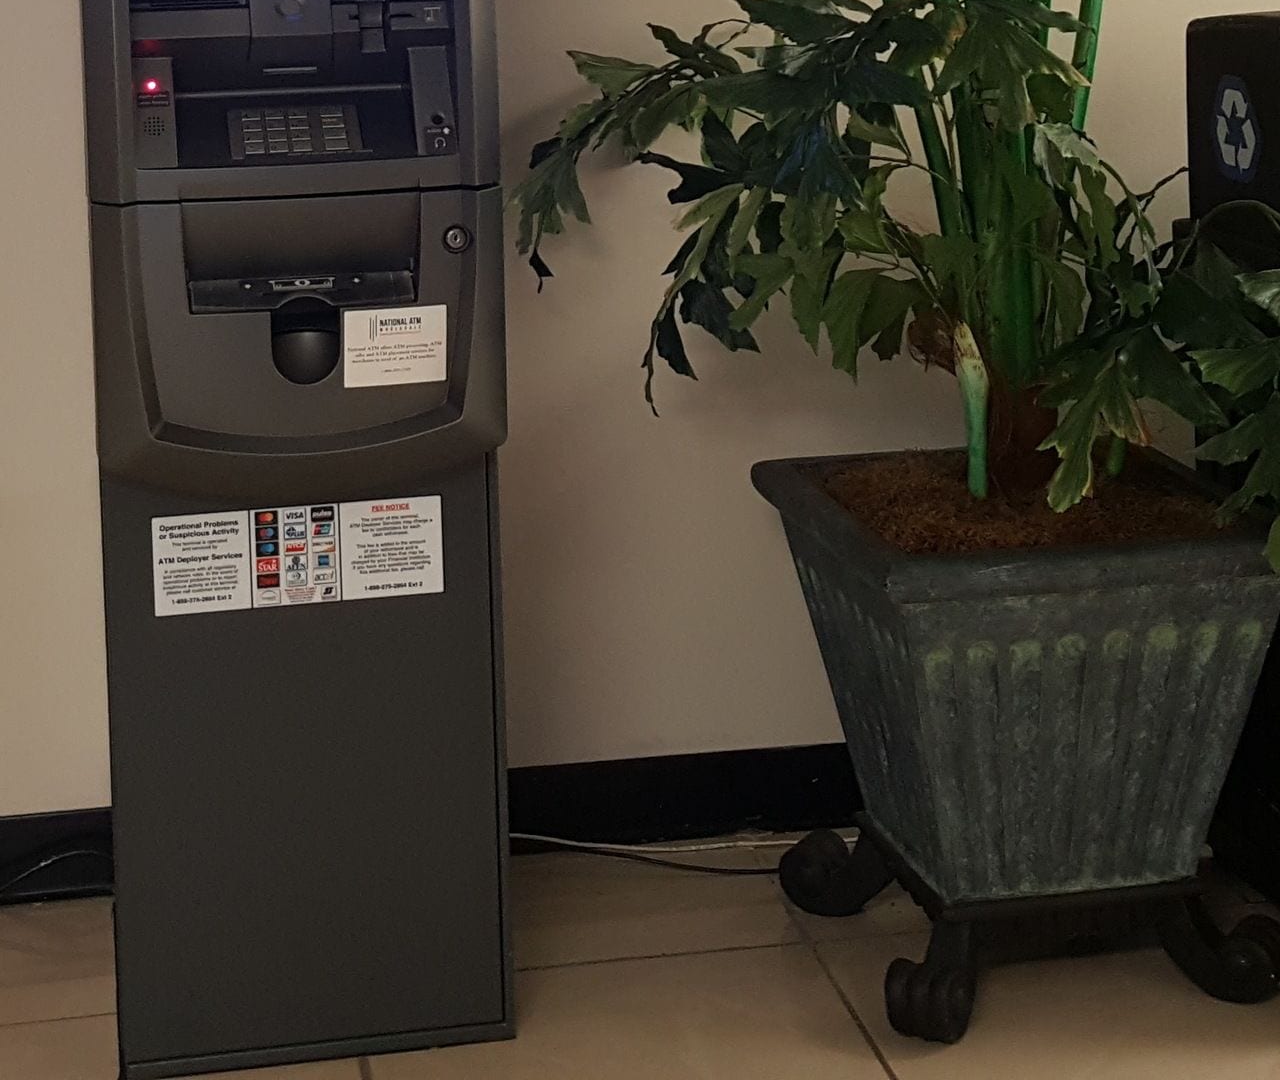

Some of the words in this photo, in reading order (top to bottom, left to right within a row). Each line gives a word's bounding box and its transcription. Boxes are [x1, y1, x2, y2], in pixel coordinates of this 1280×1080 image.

[379, 317, 407, 326] NATIONAL
[408, 316, 422, 324] ATM
[385, 503, 411, 511] NOTICE
[285, 511, 304, 520] VISA
[159, 522, 202, 533] Operational
[203, 519, 239, 528] Problems
[168, 530, 210, 540] Suspicious
[211, 527, 240, 536] Activity
[158, 557, 175, 565] ATM
[176, 555, 210, 565] Deployer
[211, 551, 243, 560] Services
[258, 561, 278, 572] STAR
